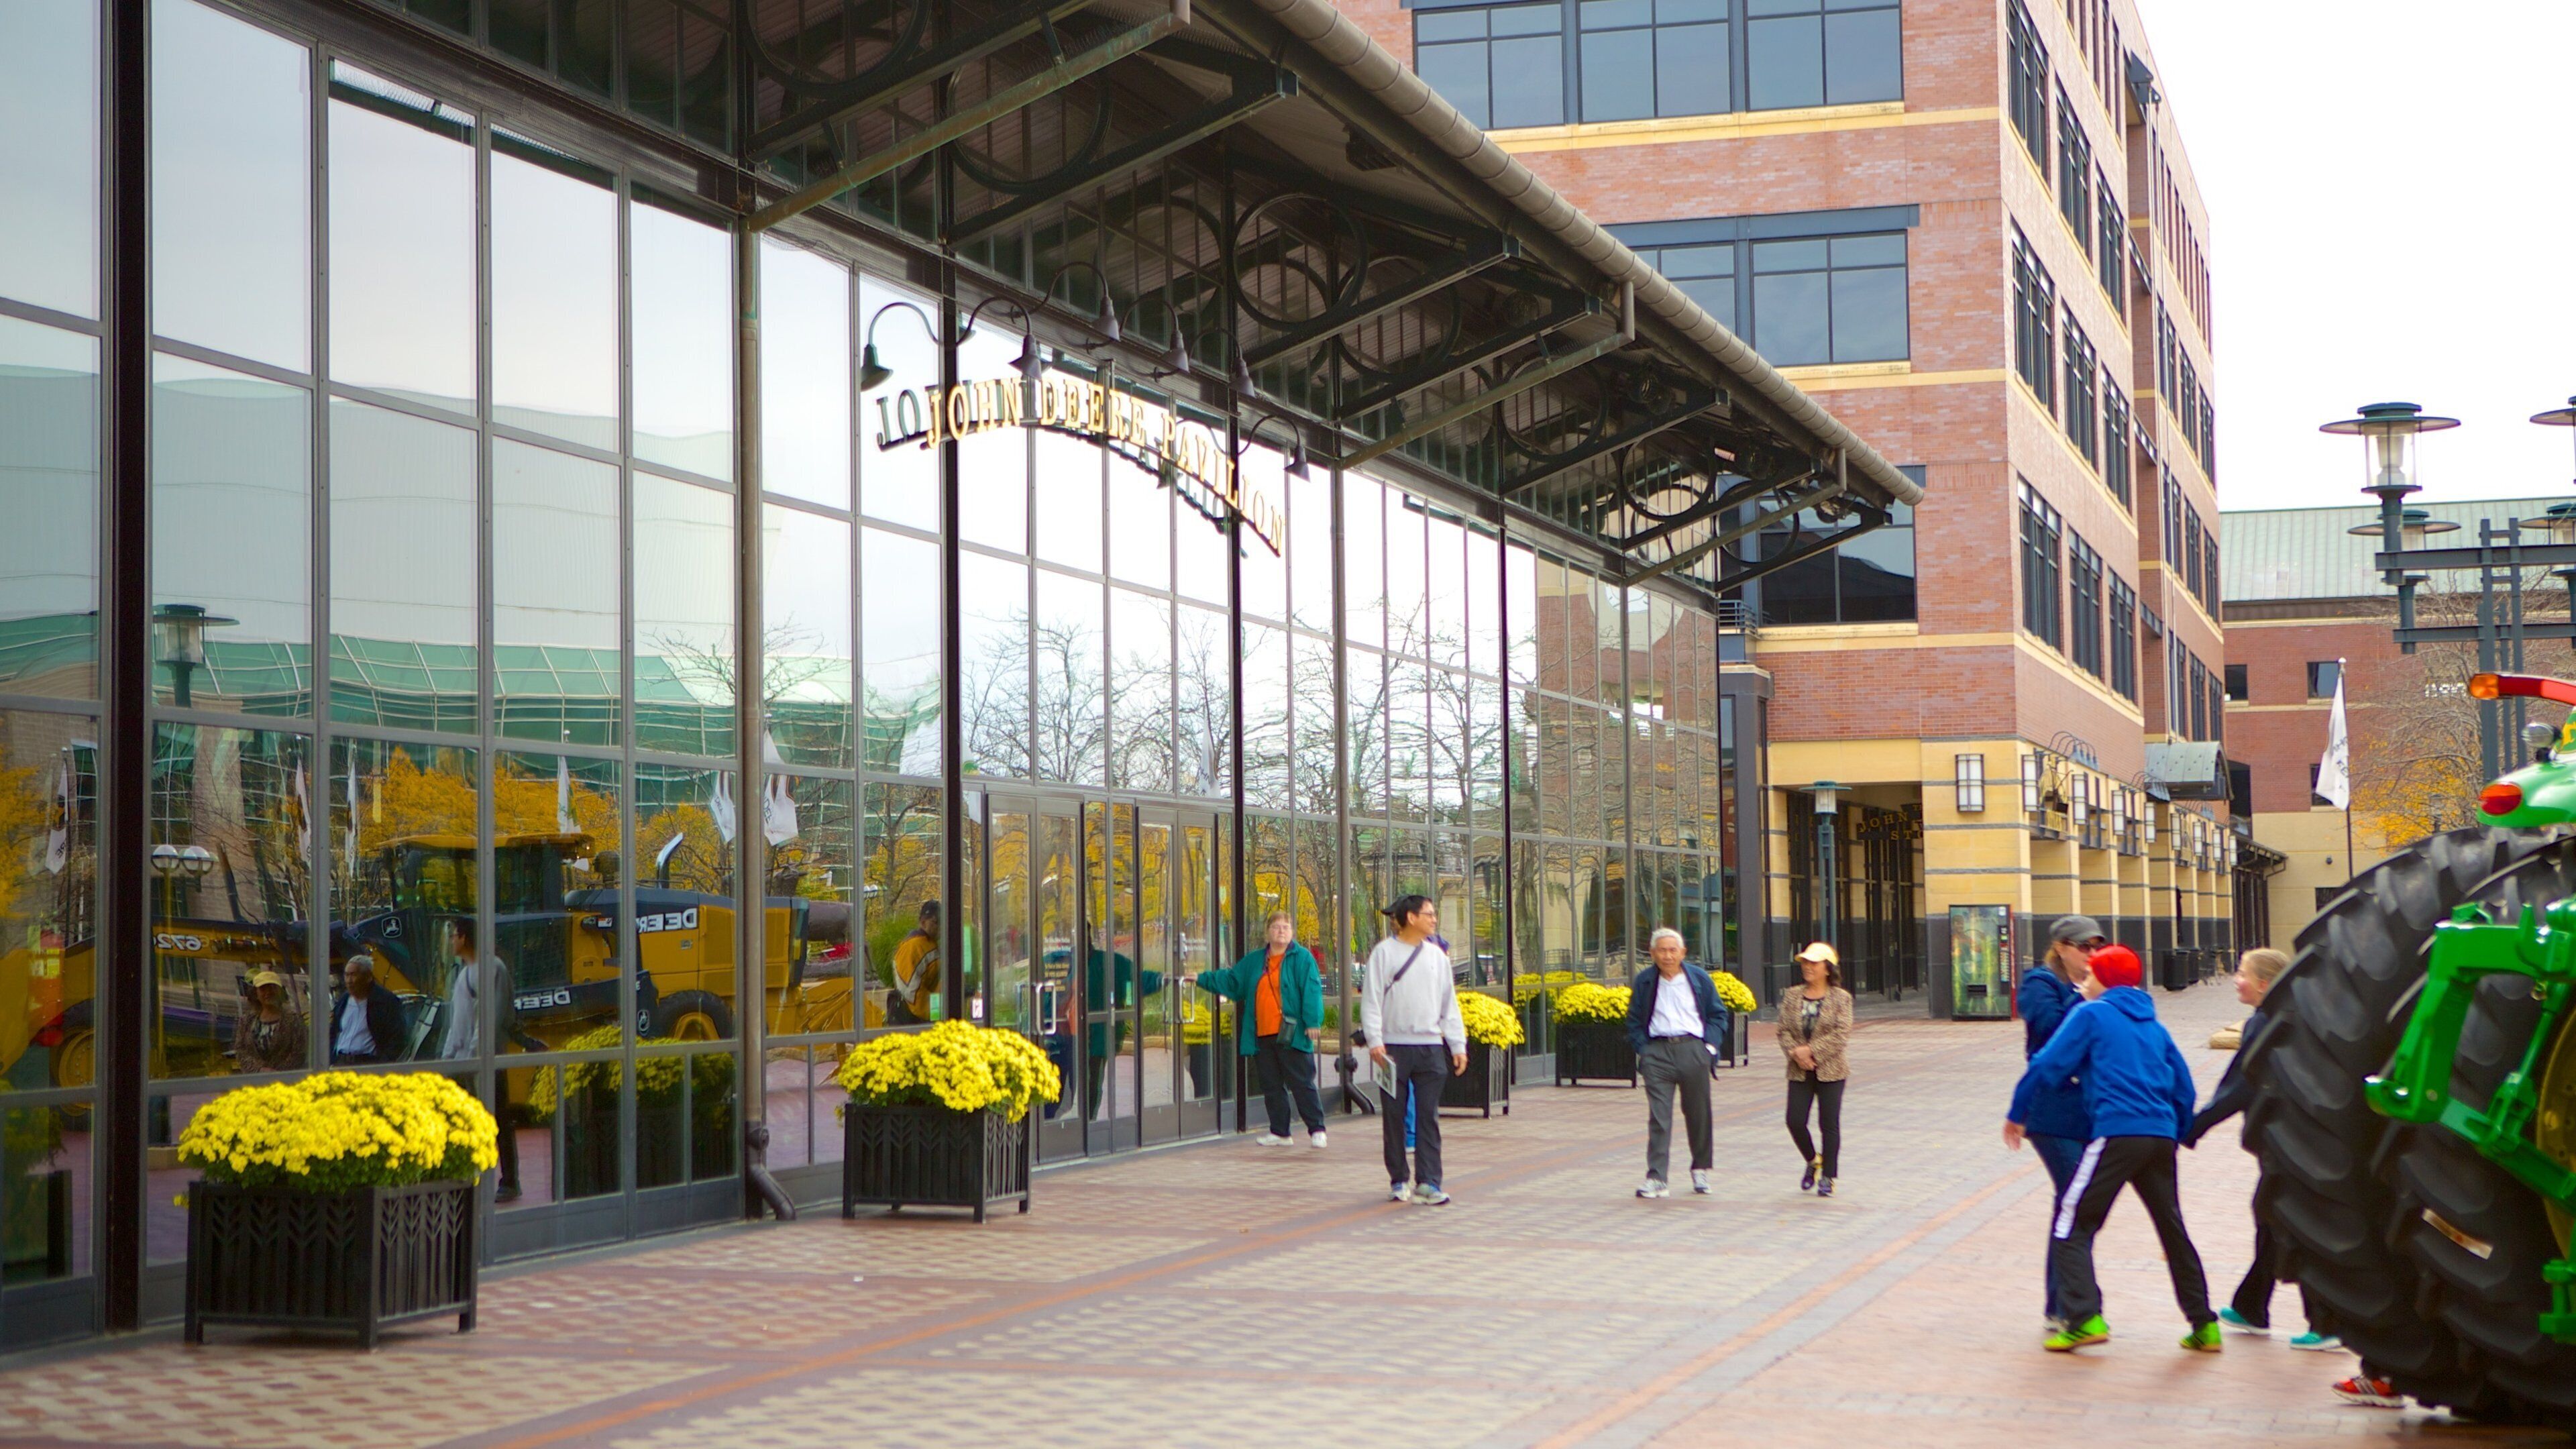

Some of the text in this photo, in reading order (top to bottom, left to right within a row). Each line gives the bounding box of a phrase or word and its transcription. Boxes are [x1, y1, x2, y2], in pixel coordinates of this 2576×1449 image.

[926, 376, 1022, 449] JOHN
[1040, 376, 1146, 447] DEERE
[1161, 412, 1283, 557] PAVILION
[1858, 812, 1908, 833] JOHN
